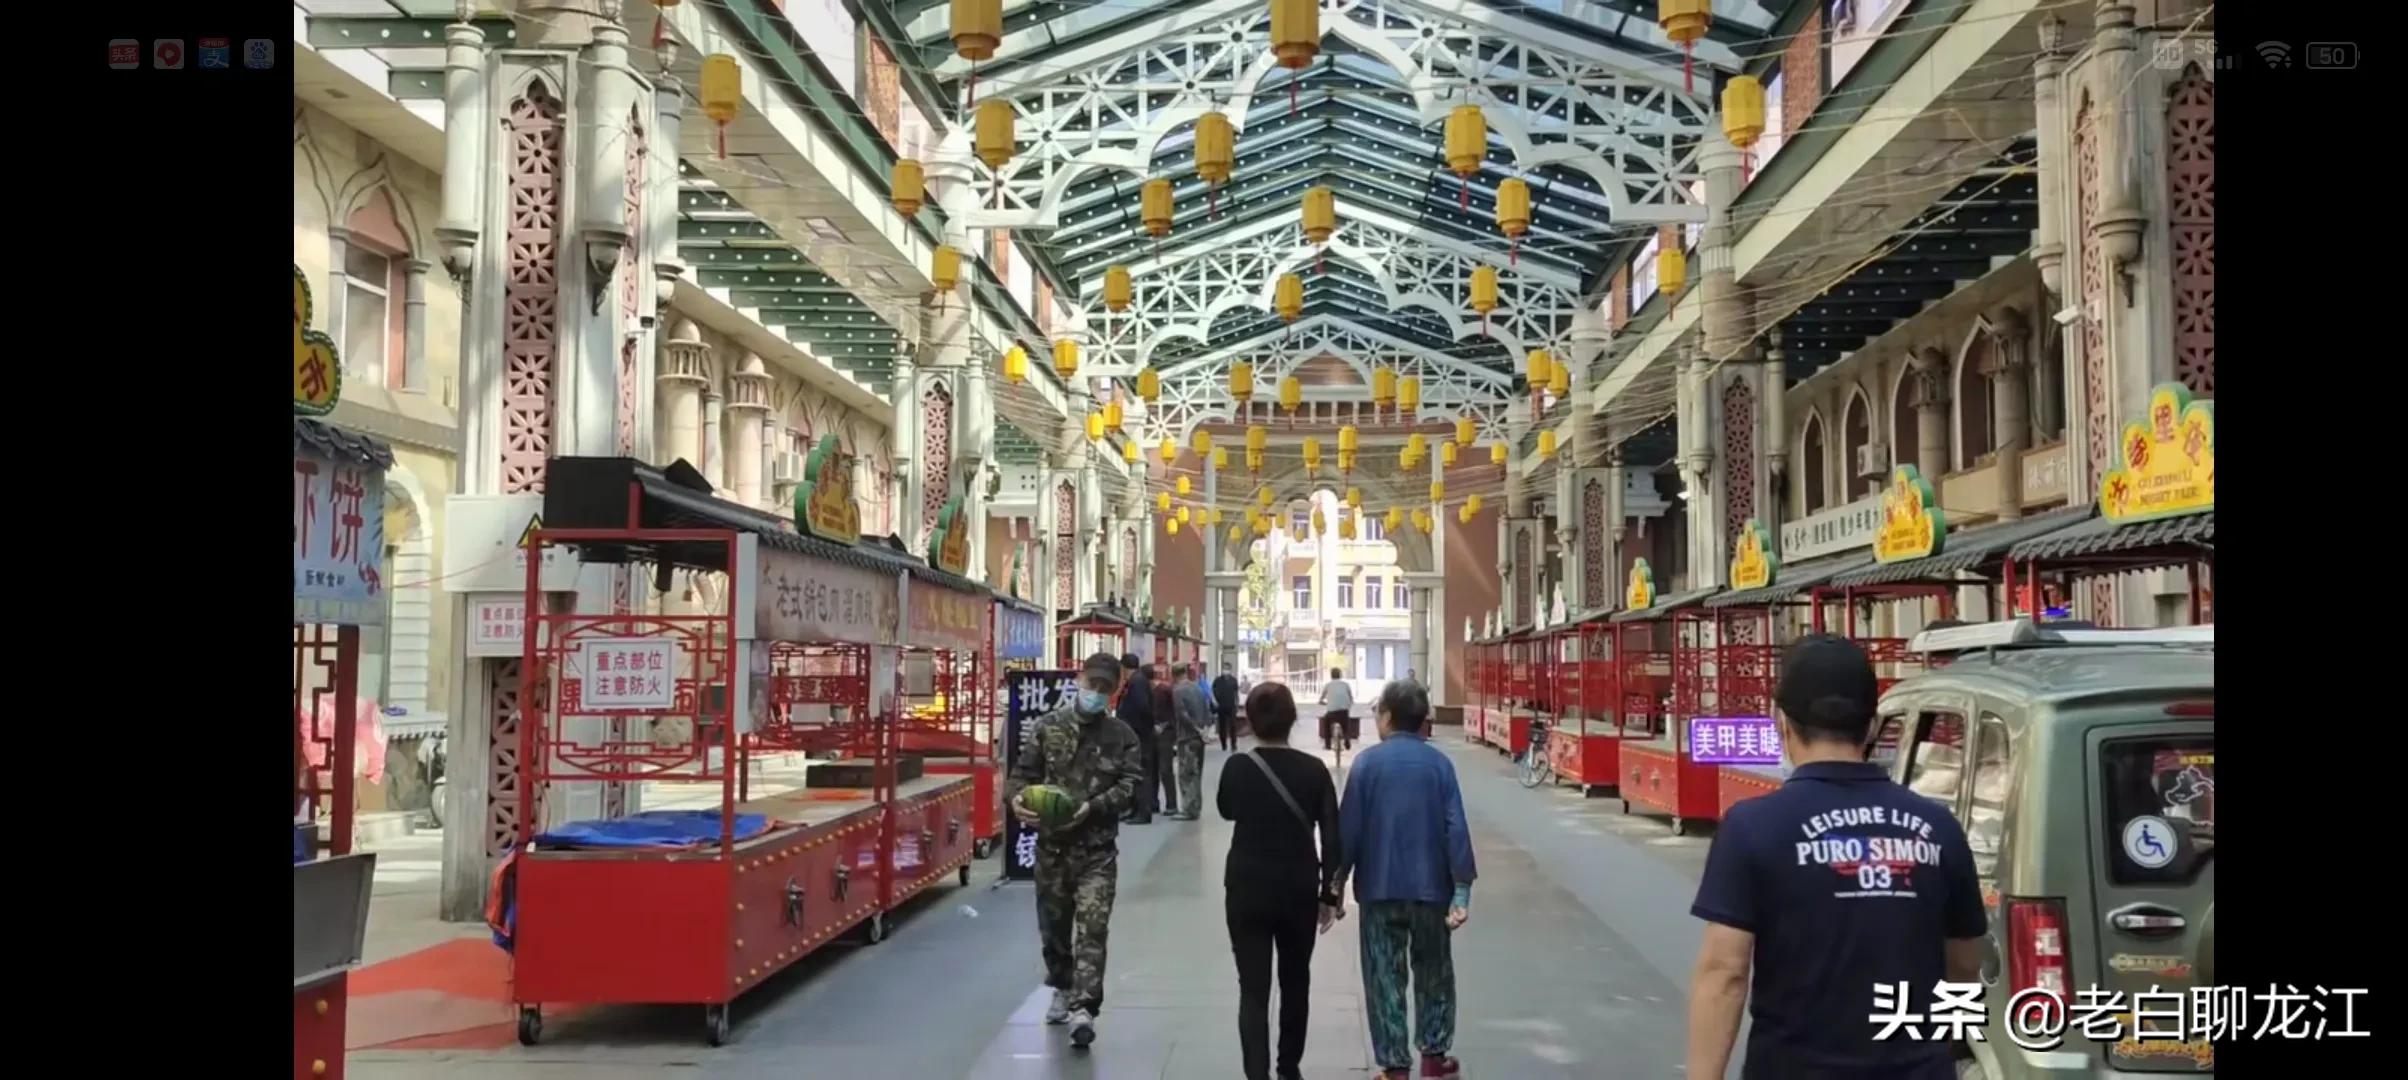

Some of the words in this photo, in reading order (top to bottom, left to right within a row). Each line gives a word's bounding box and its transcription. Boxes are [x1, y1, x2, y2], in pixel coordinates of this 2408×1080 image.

[595, 651, 664, 671] 重点部位
[595, 676, 662, 696] 注意防火
[1017, 677, 1080, 713] 批发
[1695, 723, 1782, 757] 美甲美睫
[1801, 806, 1886, 840] LEISURE
[1891, 807, 1933, 840] LIFE
[1795, 838, 1863, 866] PURO
[1868, 836, 1943, 868] SIMON
[1857, 864, 1892, 889] 03
